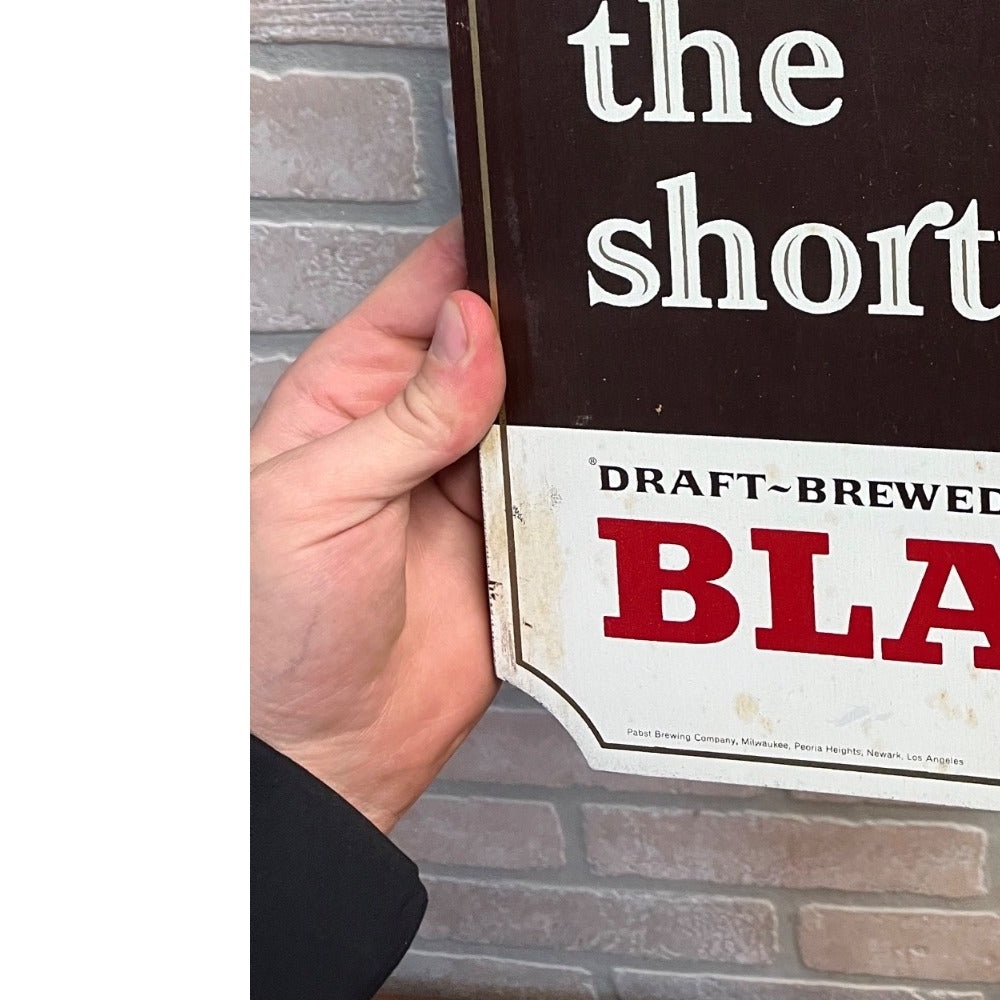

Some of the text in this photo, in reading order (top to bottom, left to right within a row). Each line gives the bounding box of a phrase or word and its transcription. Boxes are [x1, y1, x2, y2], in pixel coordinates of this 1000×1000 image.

[627, 727, 964, 767] Pabst Brewing Company, Milwaukee, Peoria Heights, Newark, Los Angeles
